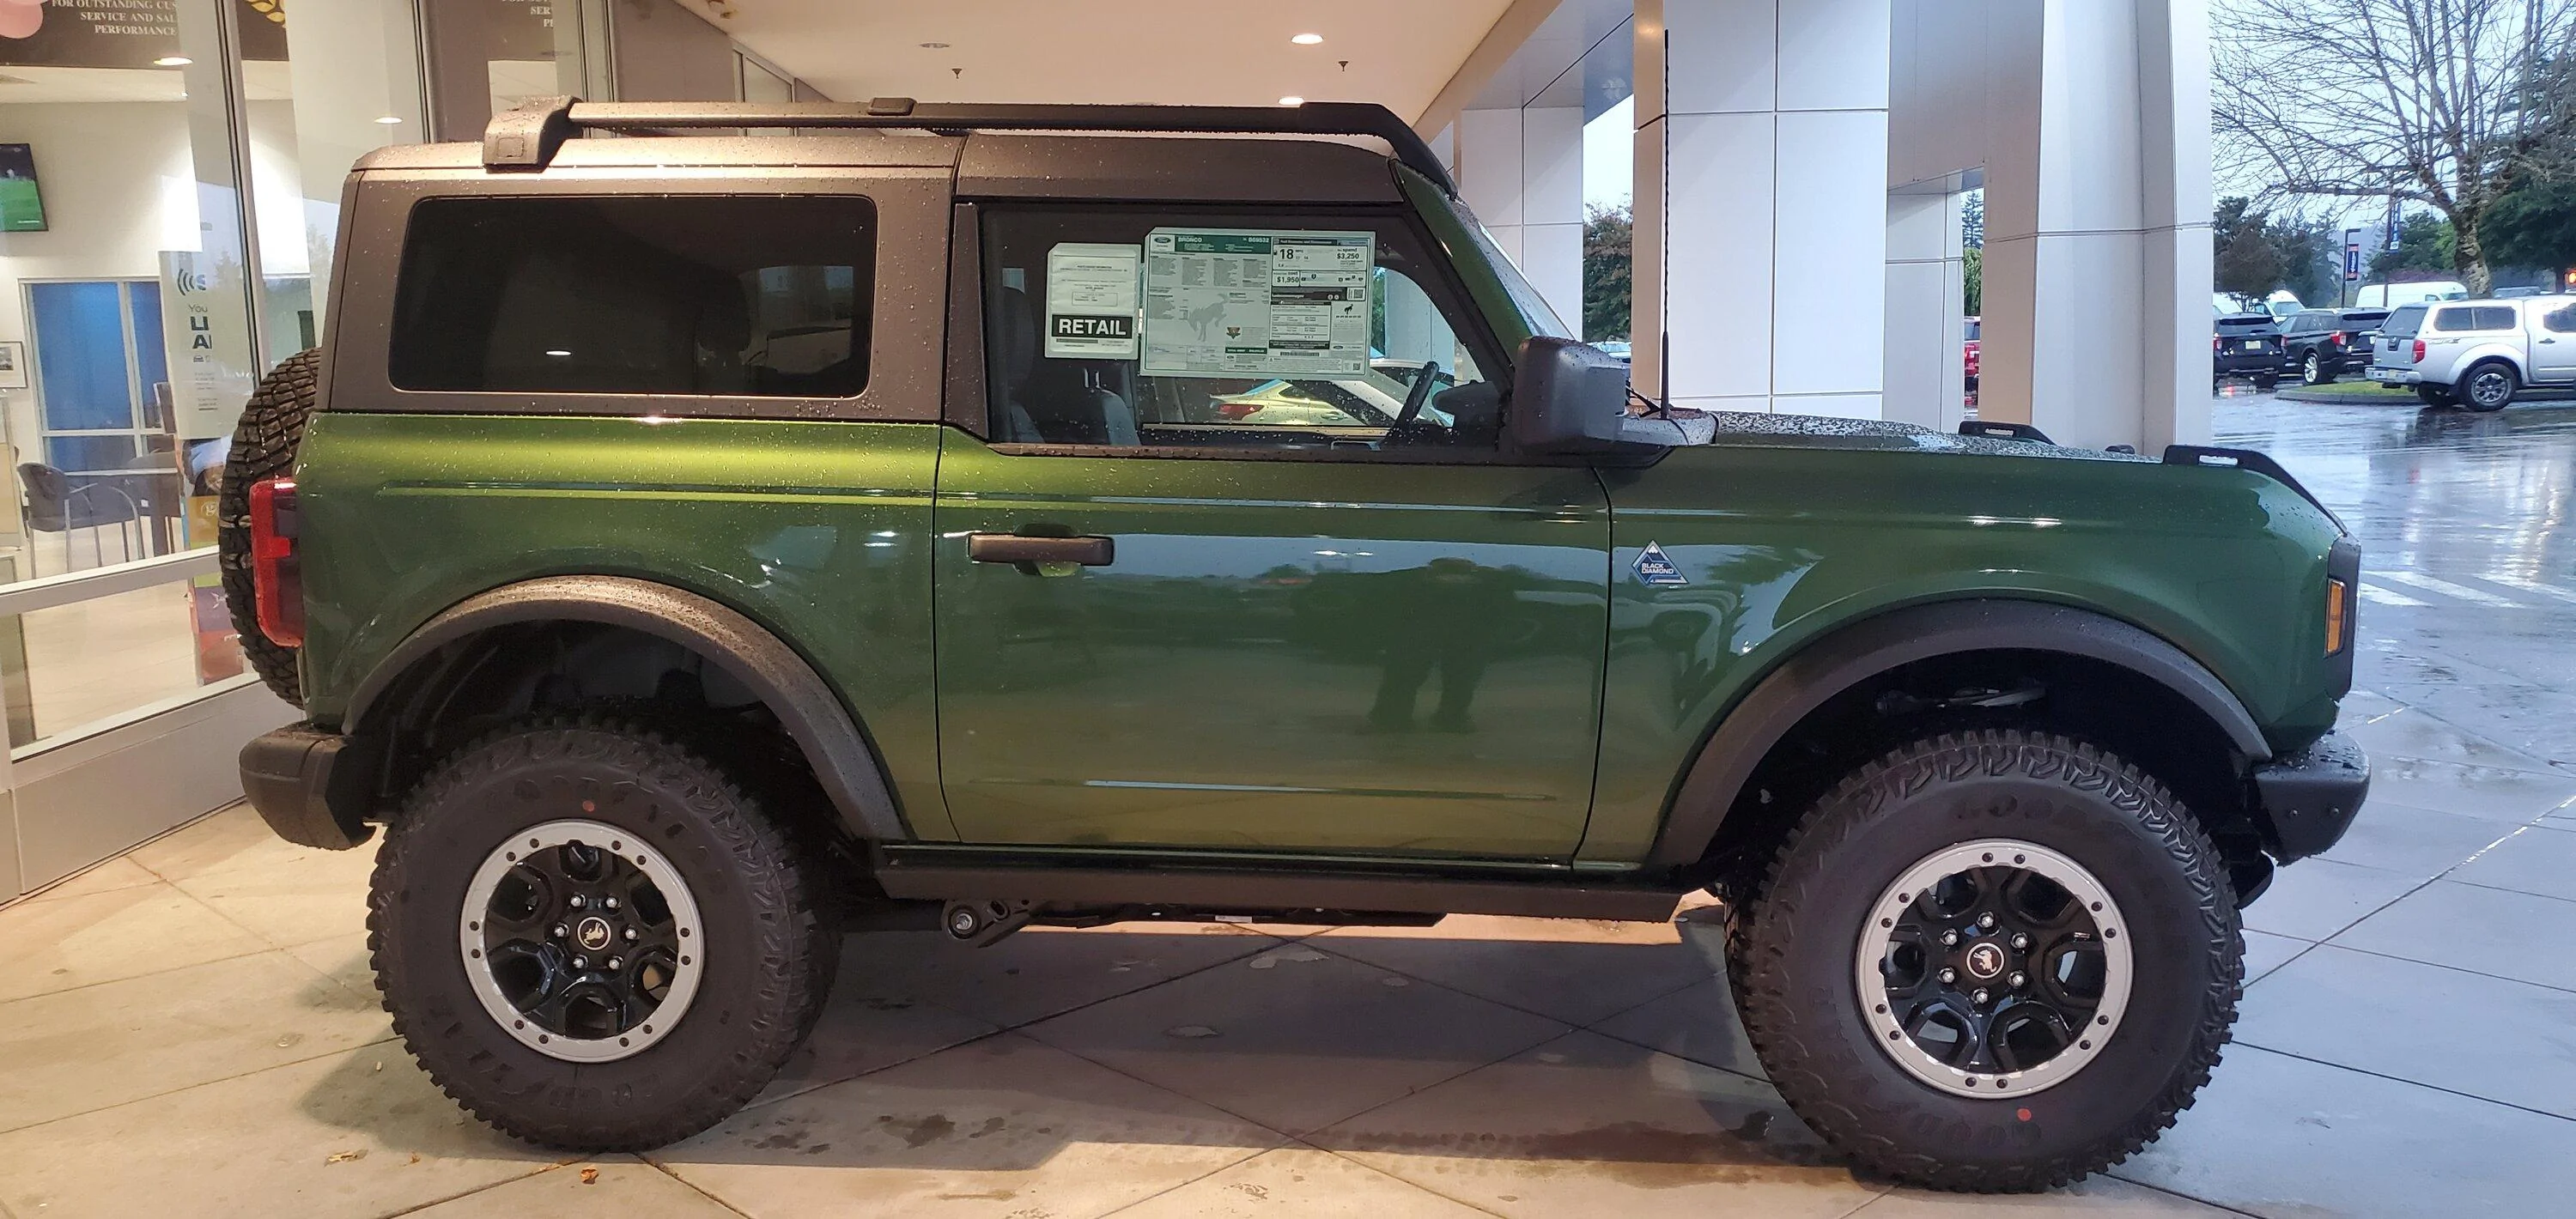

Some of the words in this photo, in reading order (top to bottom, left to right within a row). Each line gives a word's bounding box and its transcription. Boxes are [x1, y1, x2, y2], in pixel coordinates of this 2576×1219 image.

[76, 0, 153, 9] OUTSTANDING
[80, 12, 127, 21] SERVICE
[130, 13, 154, 22] AND
[156, 14, 176, 23] SAL
[94, 24, 177, 36] PERFORMANCE
[1279, 248, 1294, 260] 18
[1277, 276, 1299, 284] $1,950
[1058, 318, 1127, 336] RETAIL
